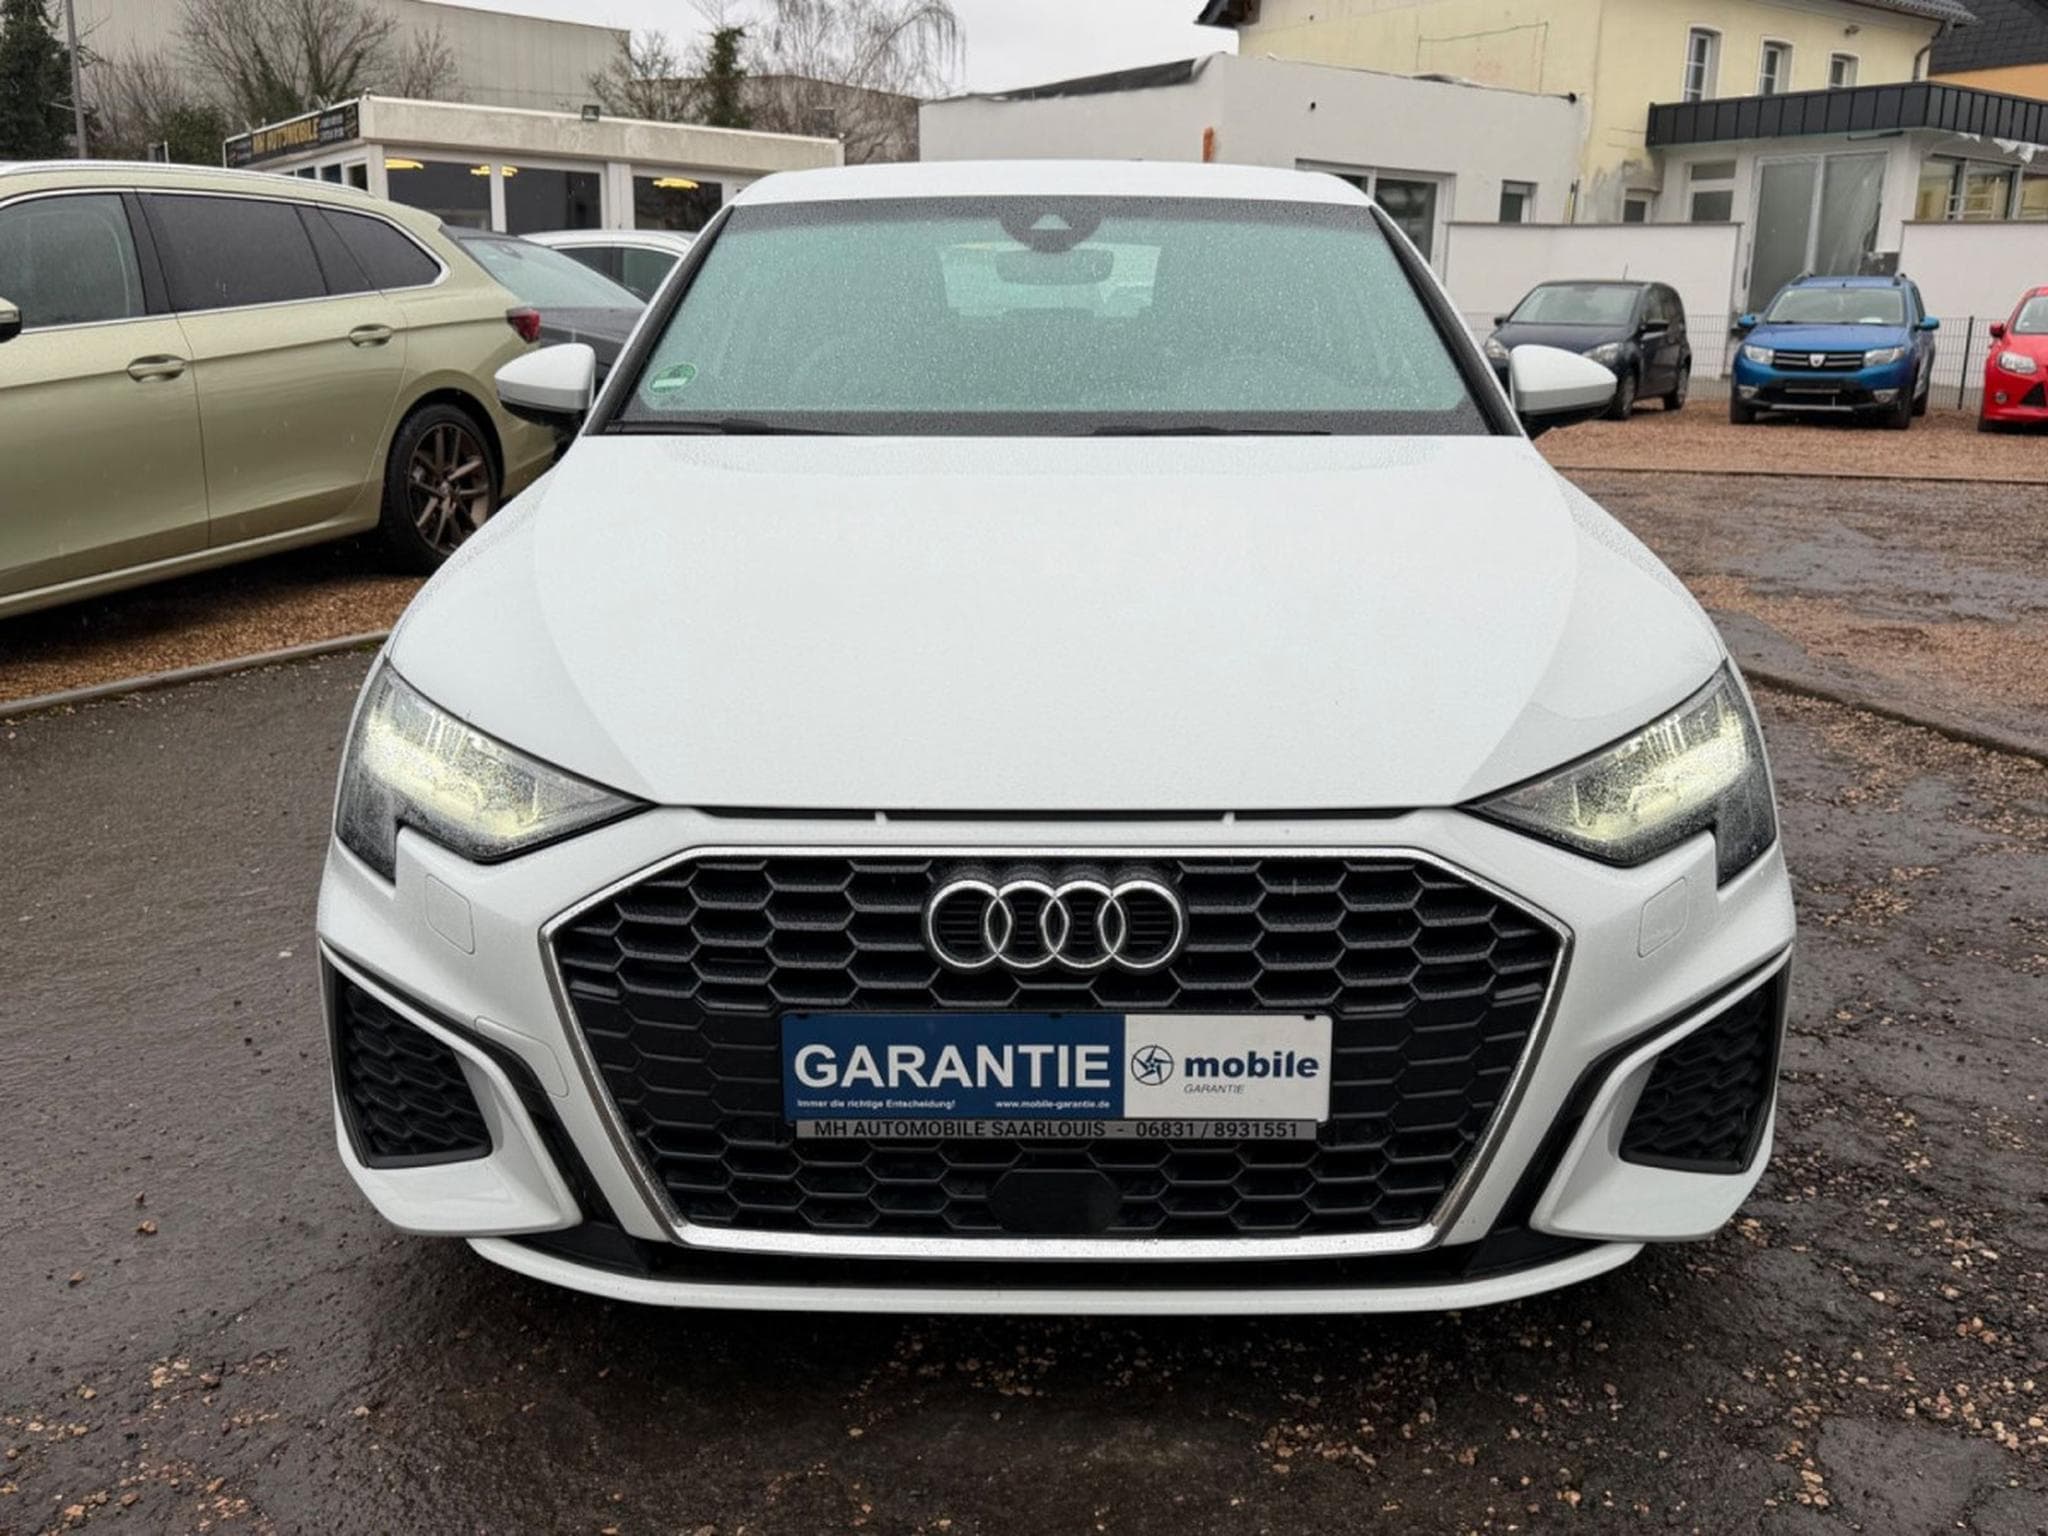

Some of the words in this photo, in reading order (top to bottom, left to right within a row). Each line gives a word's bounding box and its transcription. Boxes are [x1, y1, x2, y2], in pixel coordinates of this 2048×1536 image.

[795, 1044, 1111, 1088] GARANTIE
[1185, 1051, 1319, 1078] mobile
[1184, 1084, 1245, 1094] GARANTIE
[797, 1100, 827, 1108] Immer
[830, 1100, 845, 1108] die
[847, 1100, 884, 1109] richtige
[886, 1099, 956, 1110] Entscheidung!
[995, 1100, 1110, 1109] www.mobile-garantie.de
[815, 1121, 847, 1136] MH
[854, 1121, 985, 1137] AUTOMOBILE
[992, 1121, 1106, 1137] SAARLOUIS
[1136, 1123, 1195, 1138] 06831
[1214, 1123, 1297, 1138] 8931551
